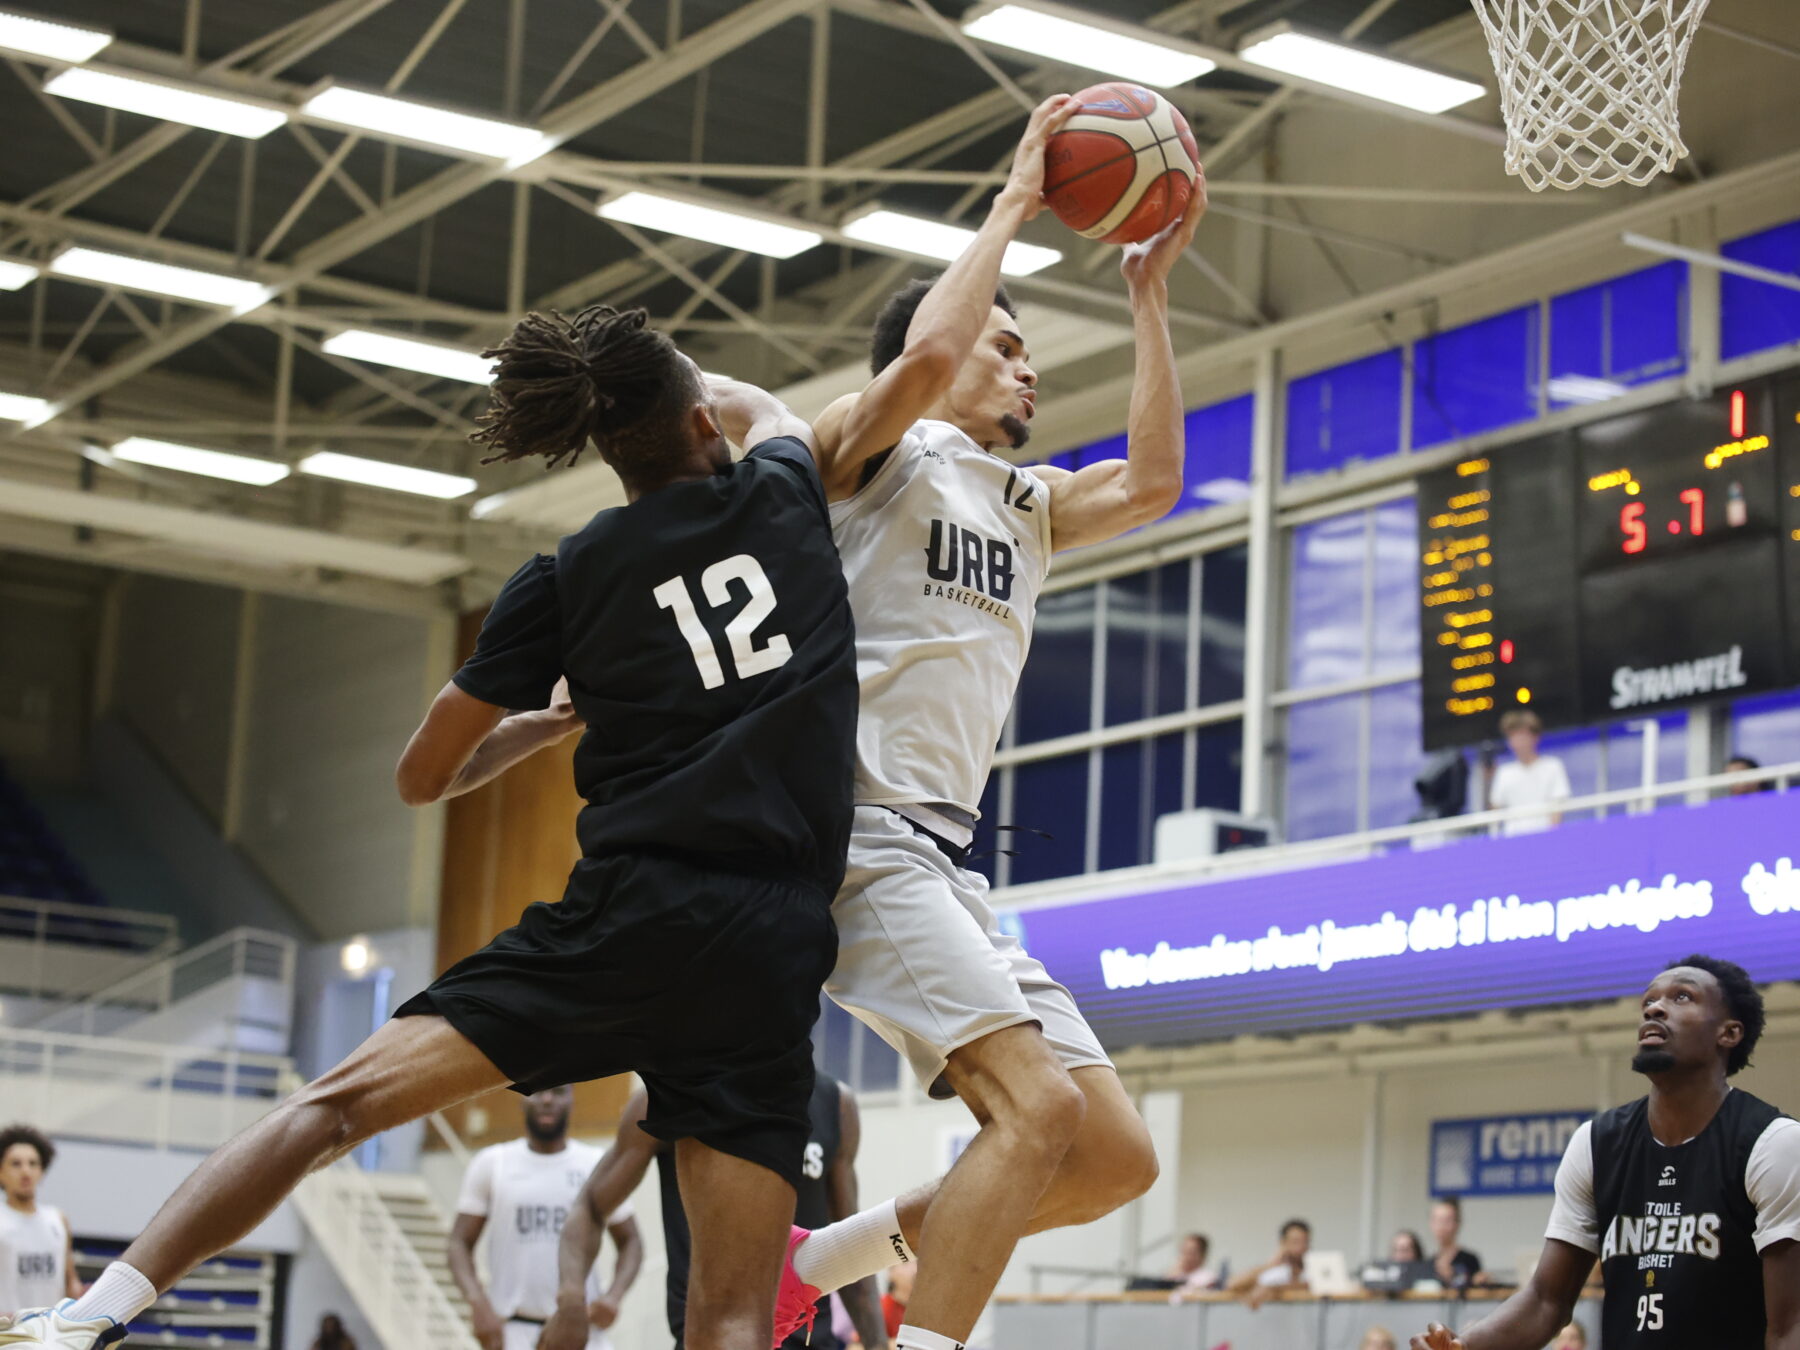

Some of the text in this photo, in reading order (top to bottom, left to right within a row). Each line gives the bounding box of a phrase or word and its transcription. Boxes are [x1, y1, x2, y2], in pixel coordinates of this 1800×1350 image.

[653, 553, 794, 690] 12
[924, 584, 1010, 620] BASKETBALL
[1645, 1201, 1681, 1217] TOILE
[1601, 1212, 1722, 1264] ANGERS
[1637, 1293, 1664, 1332] 95
